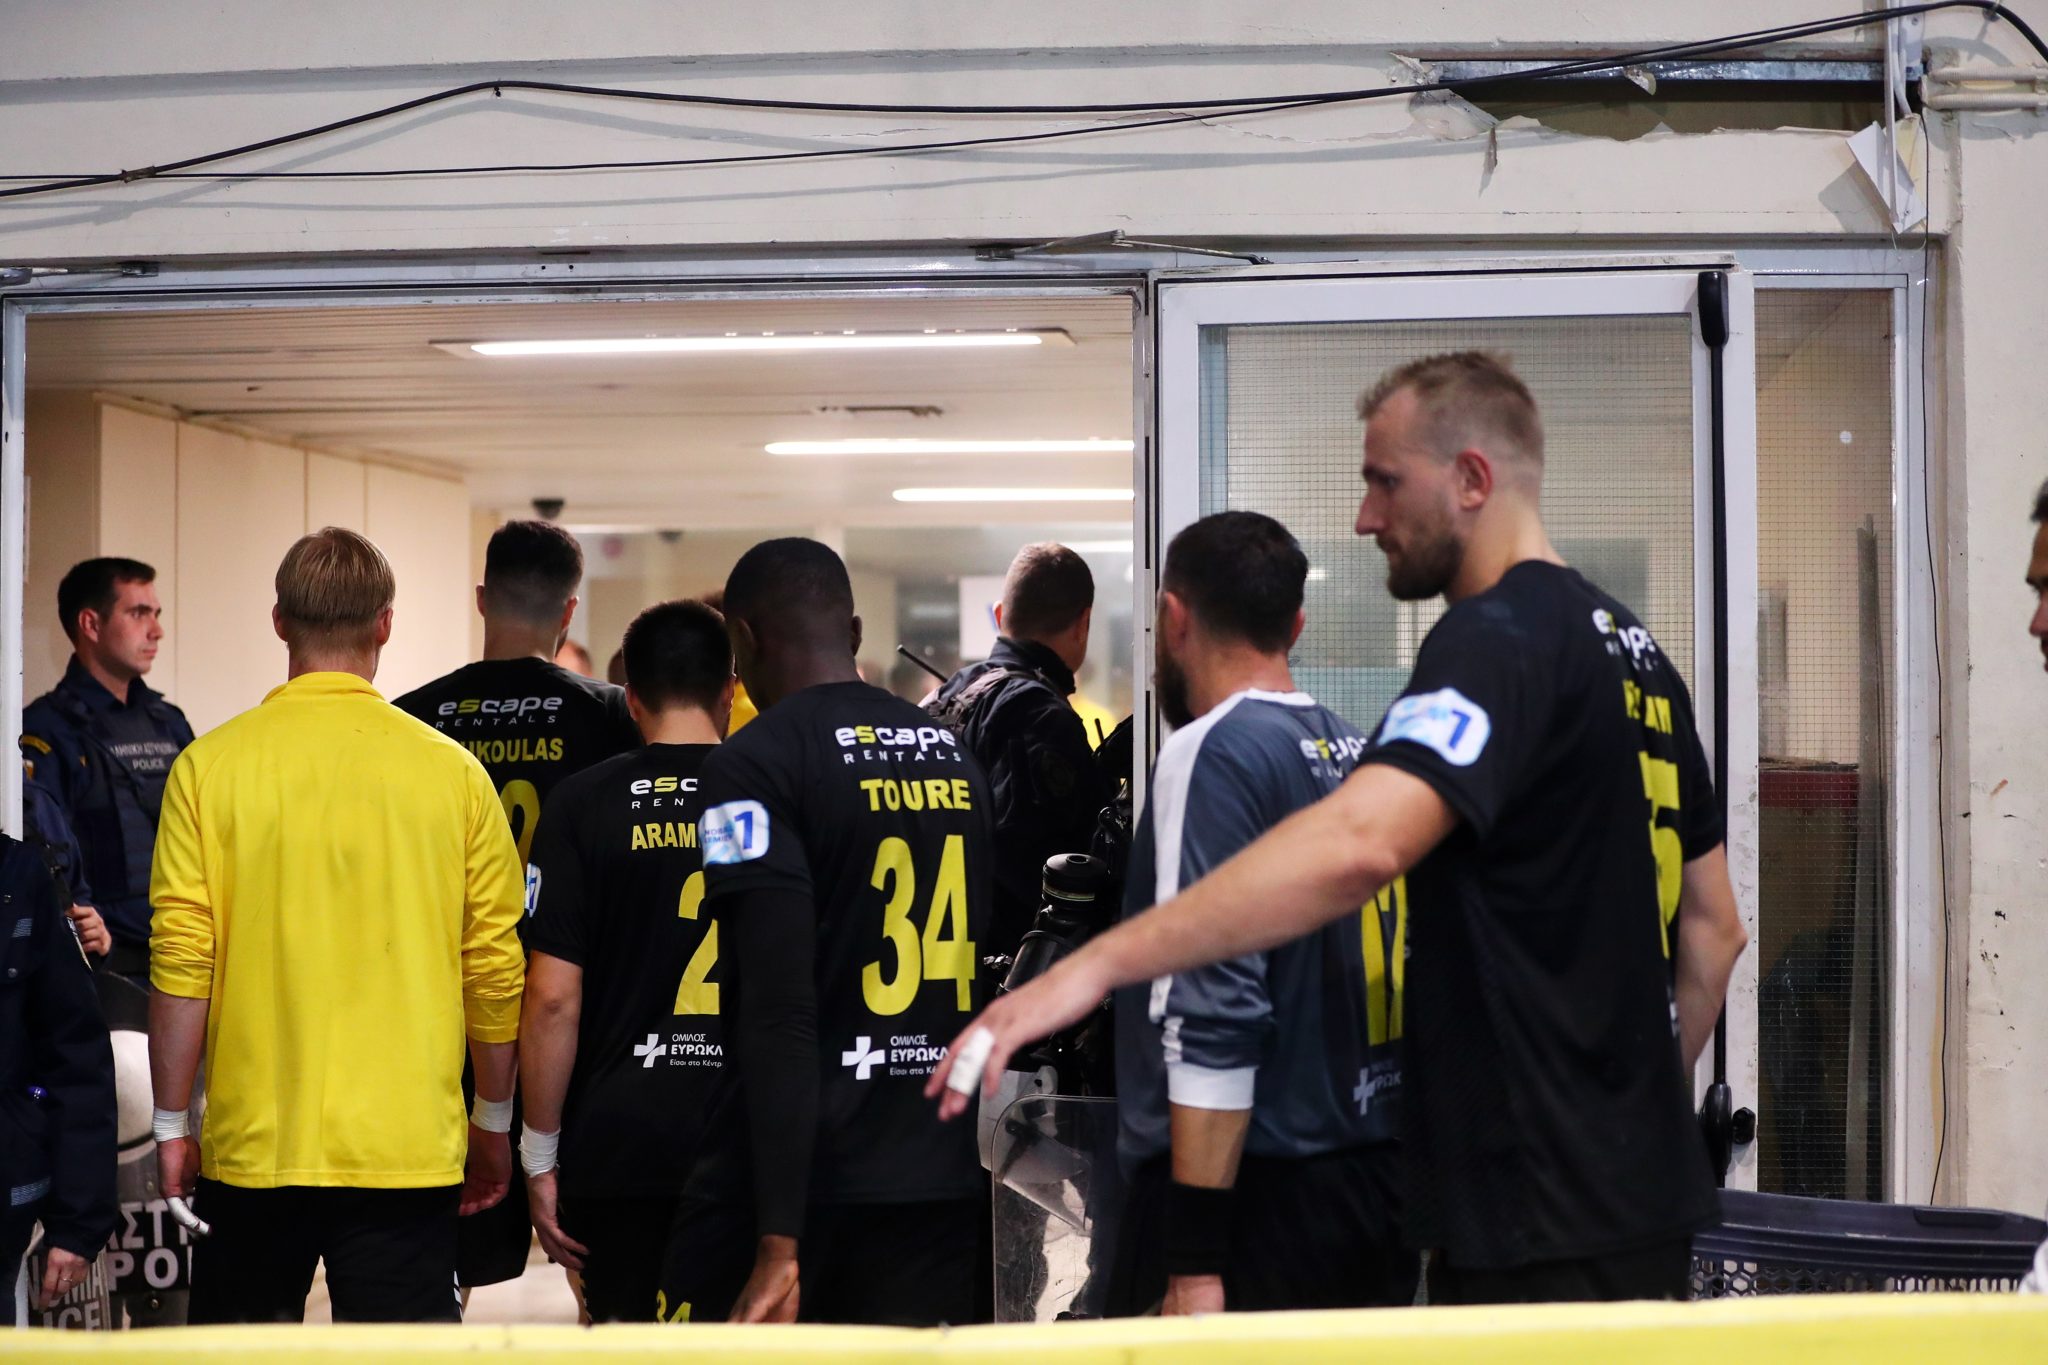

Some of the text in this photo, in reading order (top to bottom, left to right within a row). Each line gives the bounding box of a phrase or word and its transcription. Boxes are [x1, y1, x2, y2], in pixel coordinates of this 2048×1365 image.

[438, 697, 563, 717] escape
[435, 715, 557, 729] RENTALS
[835, 725, 956, 752] escape
[132, 759, 165, 770] POLICE
[843, 750, 962, 764] RENTALS
[630, 776, 698, 795] esc
[860, 778, 971, 812] TOURE
[631, 798, 684, 809] REN
[862, 834, 976, 1017] 34
[673, 871, 720, 1015] 2
[672, 1033, 706, 1042] ΟΜΙΛΟΣ
[890, 1034, 928, 1046] ΟΜΙΛΟΣ
